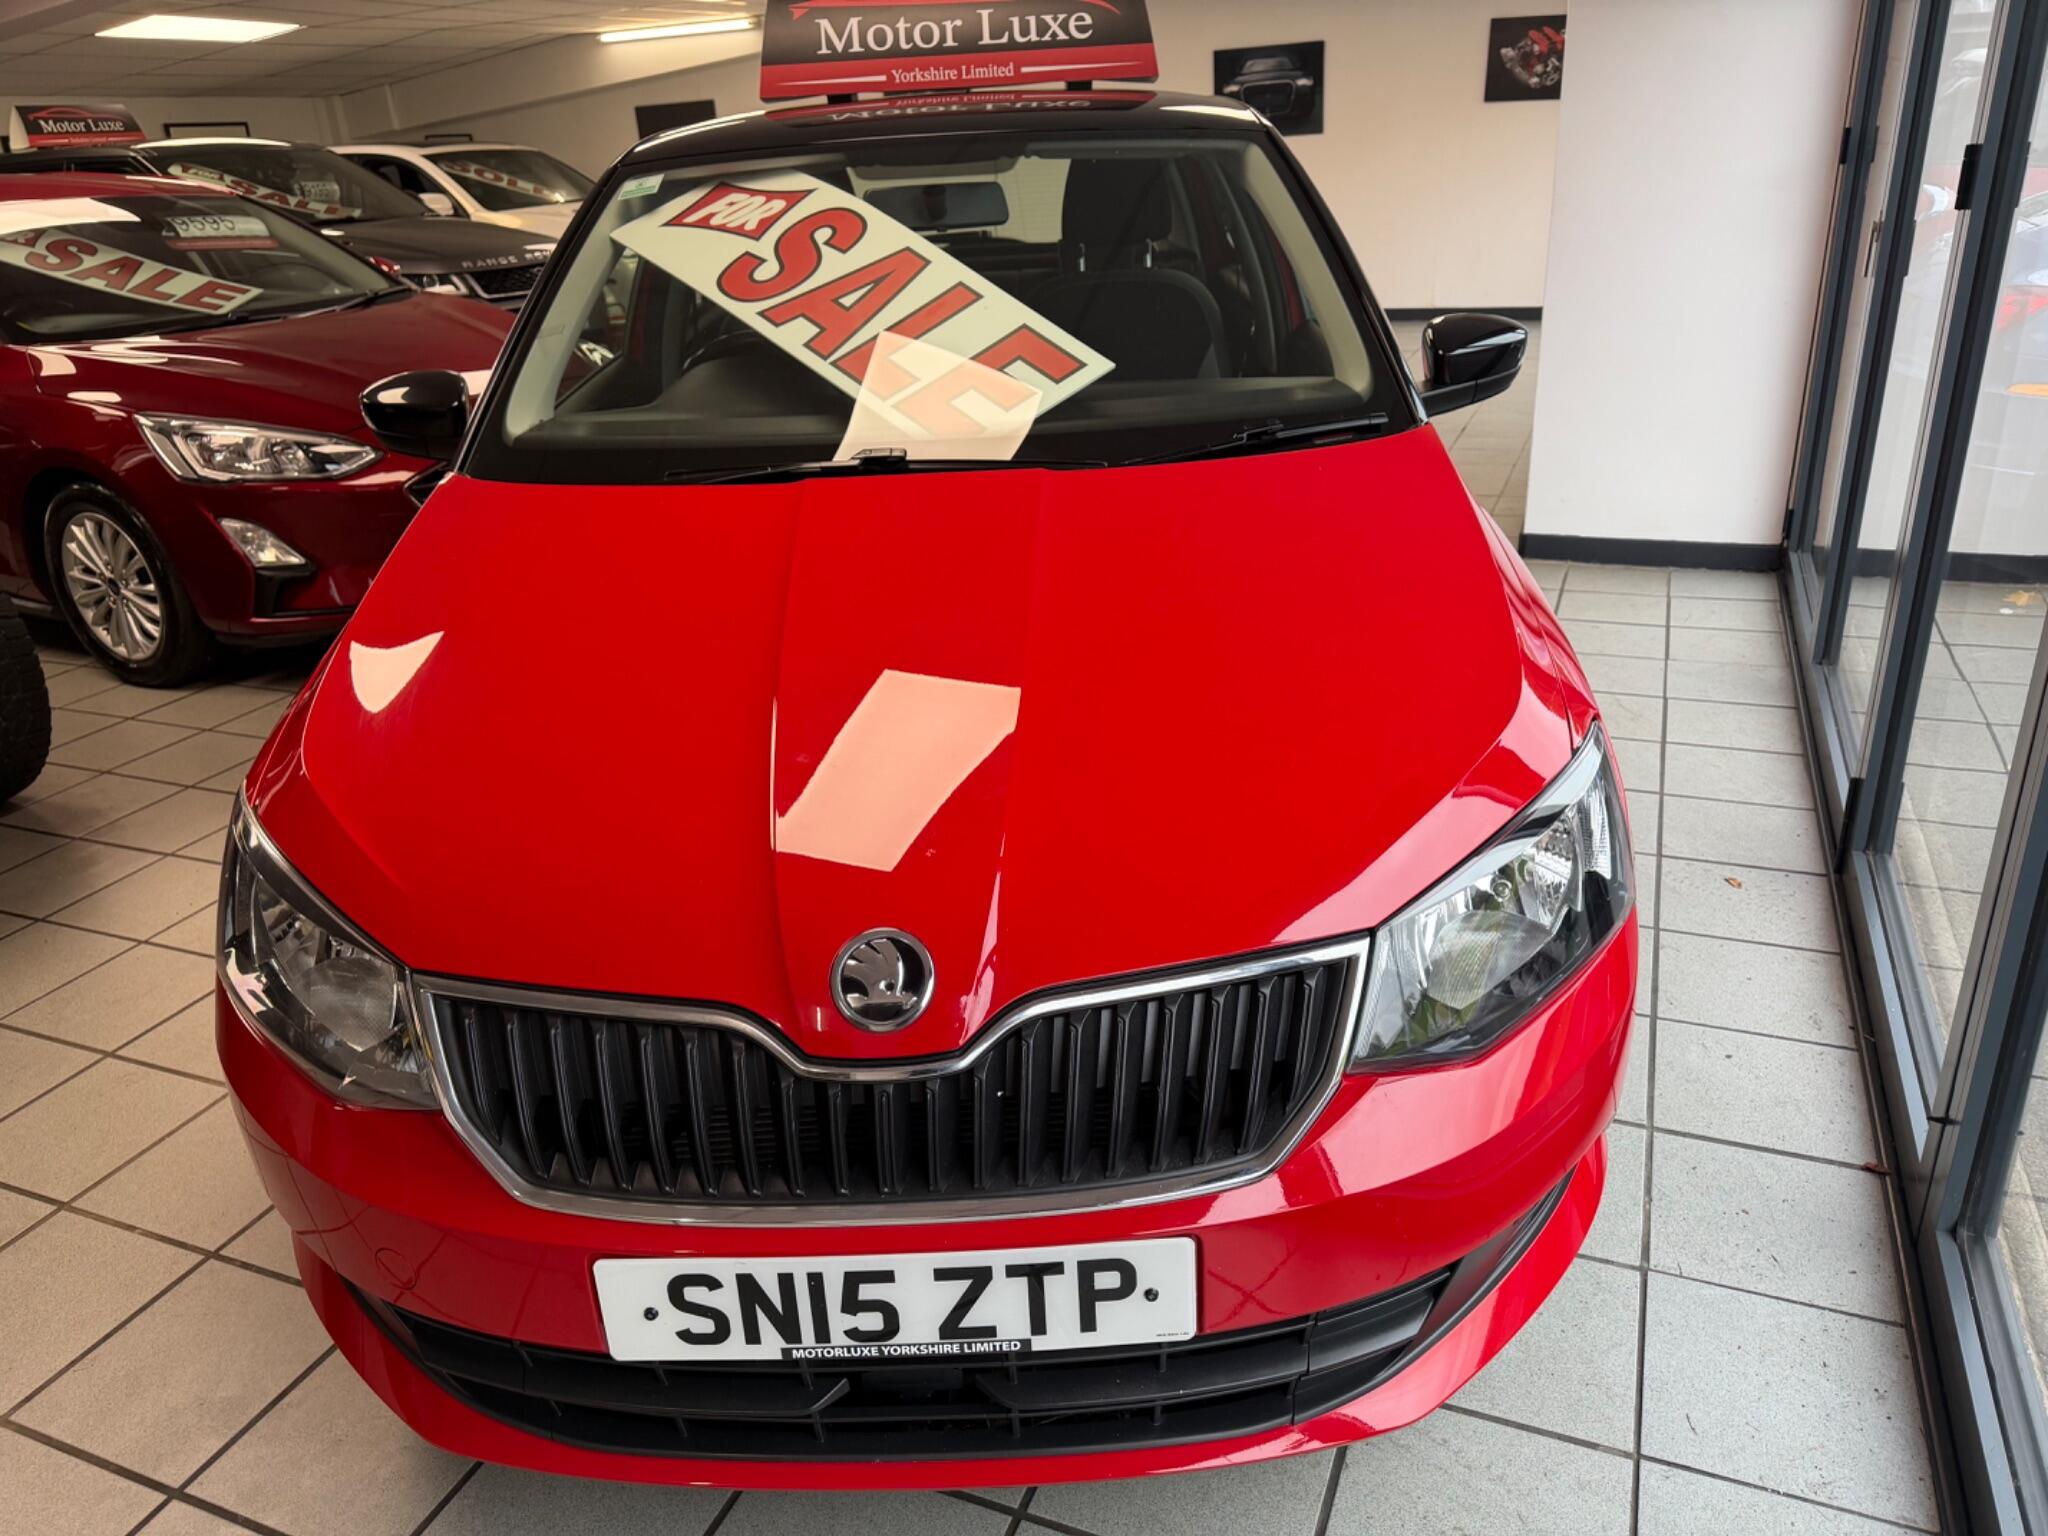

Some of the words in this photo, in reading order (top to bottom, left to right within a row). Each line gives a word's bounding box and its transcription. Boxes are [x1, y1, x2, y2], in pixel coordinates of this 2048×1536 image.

[814, 16, 962, 54] Motor
[976, 9, 1094, 46] Luxe
[891, 64, 958, 83] Yorkshire
[962, 62, 1015, 80] Limited
[39, 119, 86, 133] Motor
[87, 119, 124, 132] Luxe
[684, 192, 787, 231] FOR
[24, 238, 252, 312] SALE
[461, 255, 518, 269] RANGE
[716, 207, 1087, 438] SALE
[666, 1269, 900, 1346] SN15
[933, 1258, 1138, 1340] ZTP
[792, 1346, 879, 1358] MOTORLUXE
[881, 1343, 960, 1356] YORKSHIRE
[964, 1341, 1021, 1353] LIMITED
